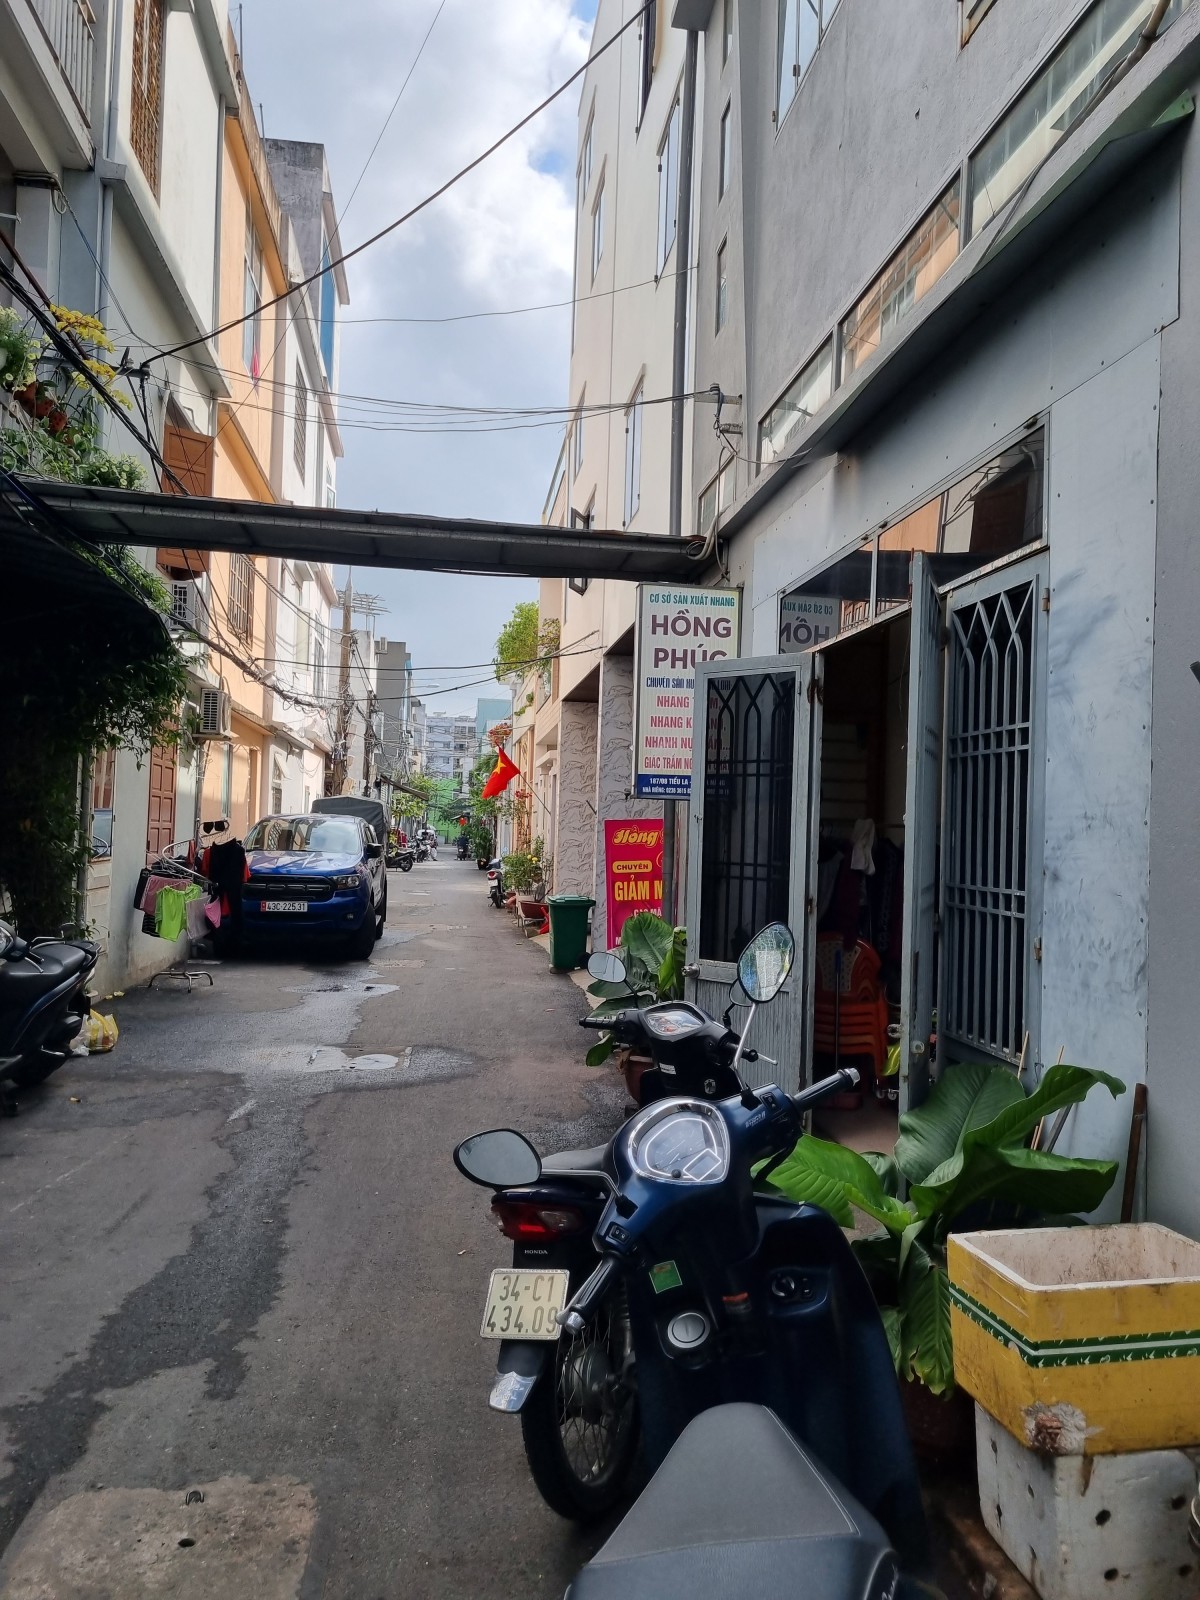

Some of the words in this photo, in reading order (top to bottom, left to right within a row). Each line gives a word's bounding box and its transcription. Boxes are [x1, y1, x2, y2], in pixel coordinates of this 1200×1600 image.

[649, 593, 660, 603] CƠ
[661, 591, 672, 604] SỞ
[673, 592, 688, 605] SẢN
[690, 592, 708, 606] XUẤT
[710, 596, 735, 607] NHANG
[652, 609, 731, 638] HỒNG
[686, 679, 695, 689] XU
[657, 696, 690, 707] NHANG
[651, 716, 683, 728] NHANG
[616, 862, 649, 871] CHUYÊN
[614, 874, 650, 901] GIẢM
[499, 1274, 555, 1303] 34-C1
[486, 1304, 559, 1334] 434.09
